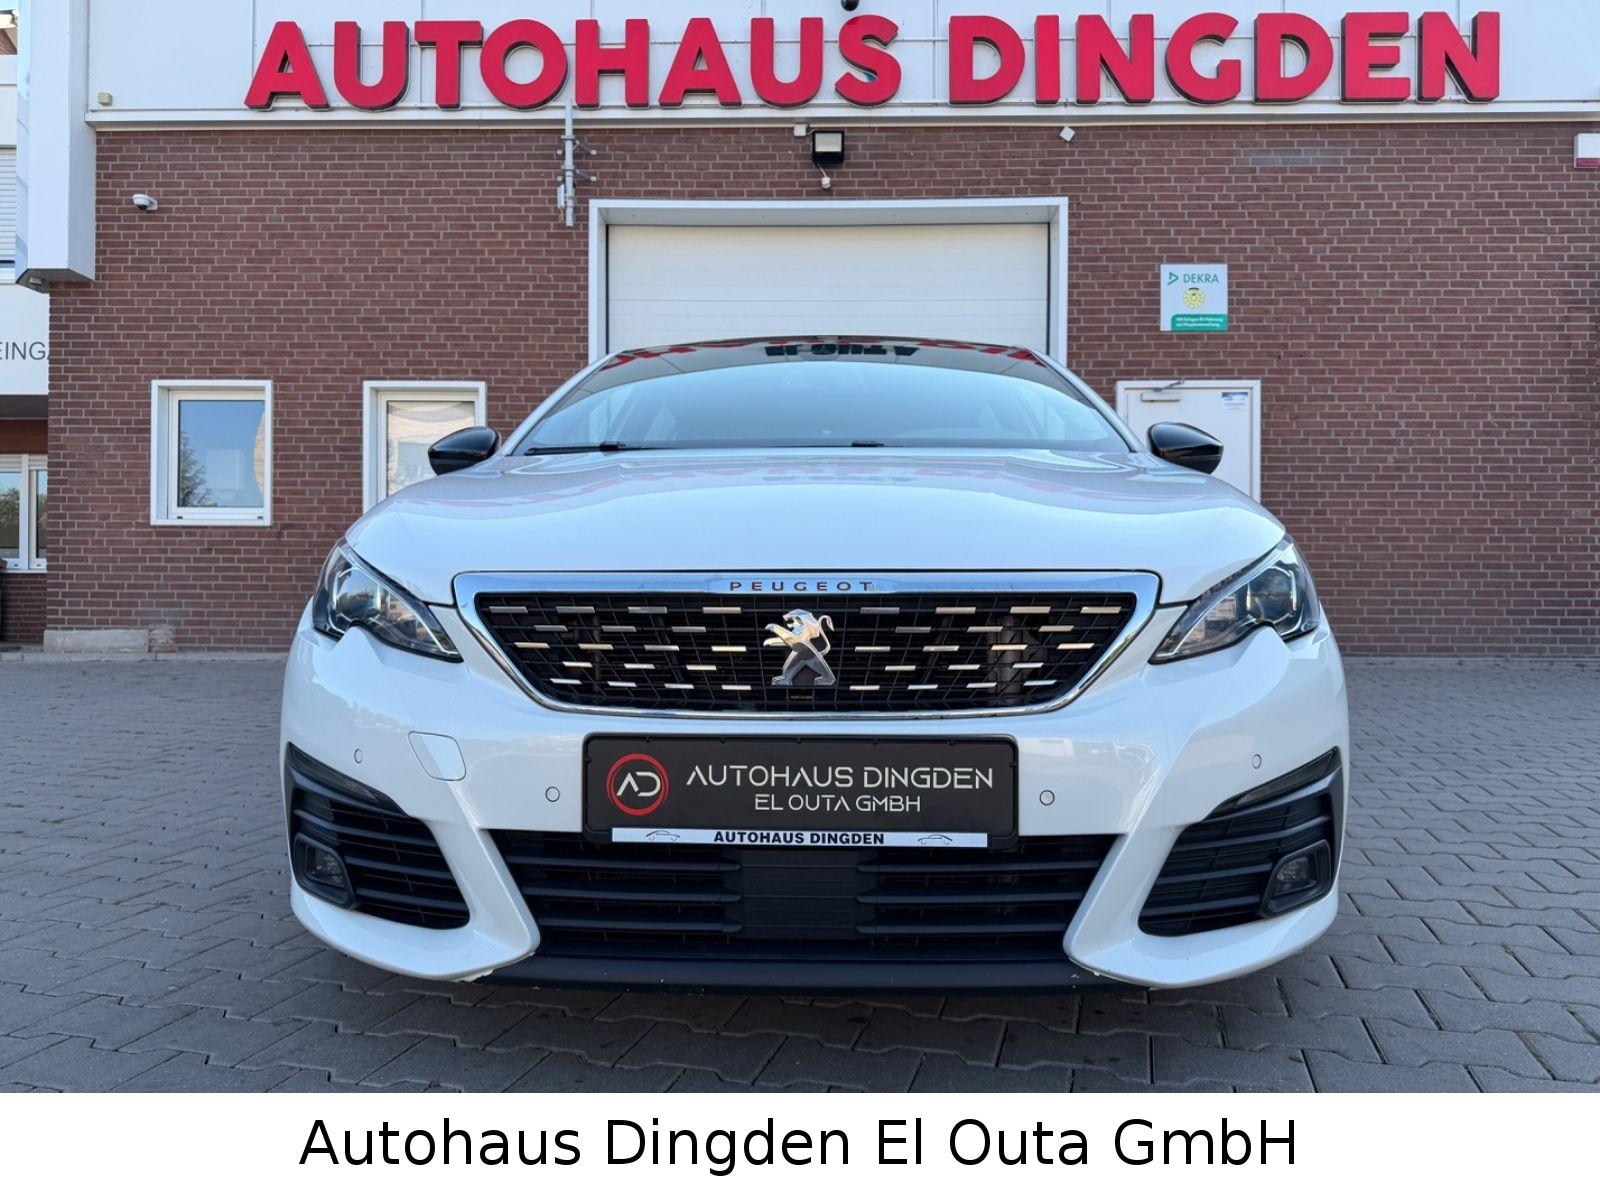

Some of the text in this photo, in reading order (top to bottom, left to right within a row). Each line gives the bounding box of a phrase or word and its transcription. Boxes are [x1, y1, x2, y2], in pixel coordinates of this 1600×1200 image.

[245, 11, 1501, 108] AUTOHAUS DINGDEN
[1183, 273, 1219, 284] DEKRA
[0, 341, 49, 360] ING
[729, 581, 873, 591] PEUGEOT
[686, 764, 993, 789] AUTOHAUS DINGDEN
[754, 793, 921, 812] EL OUTA GMBH
[713, 830, 885, 846] AUTOHAUS DINGDEN
